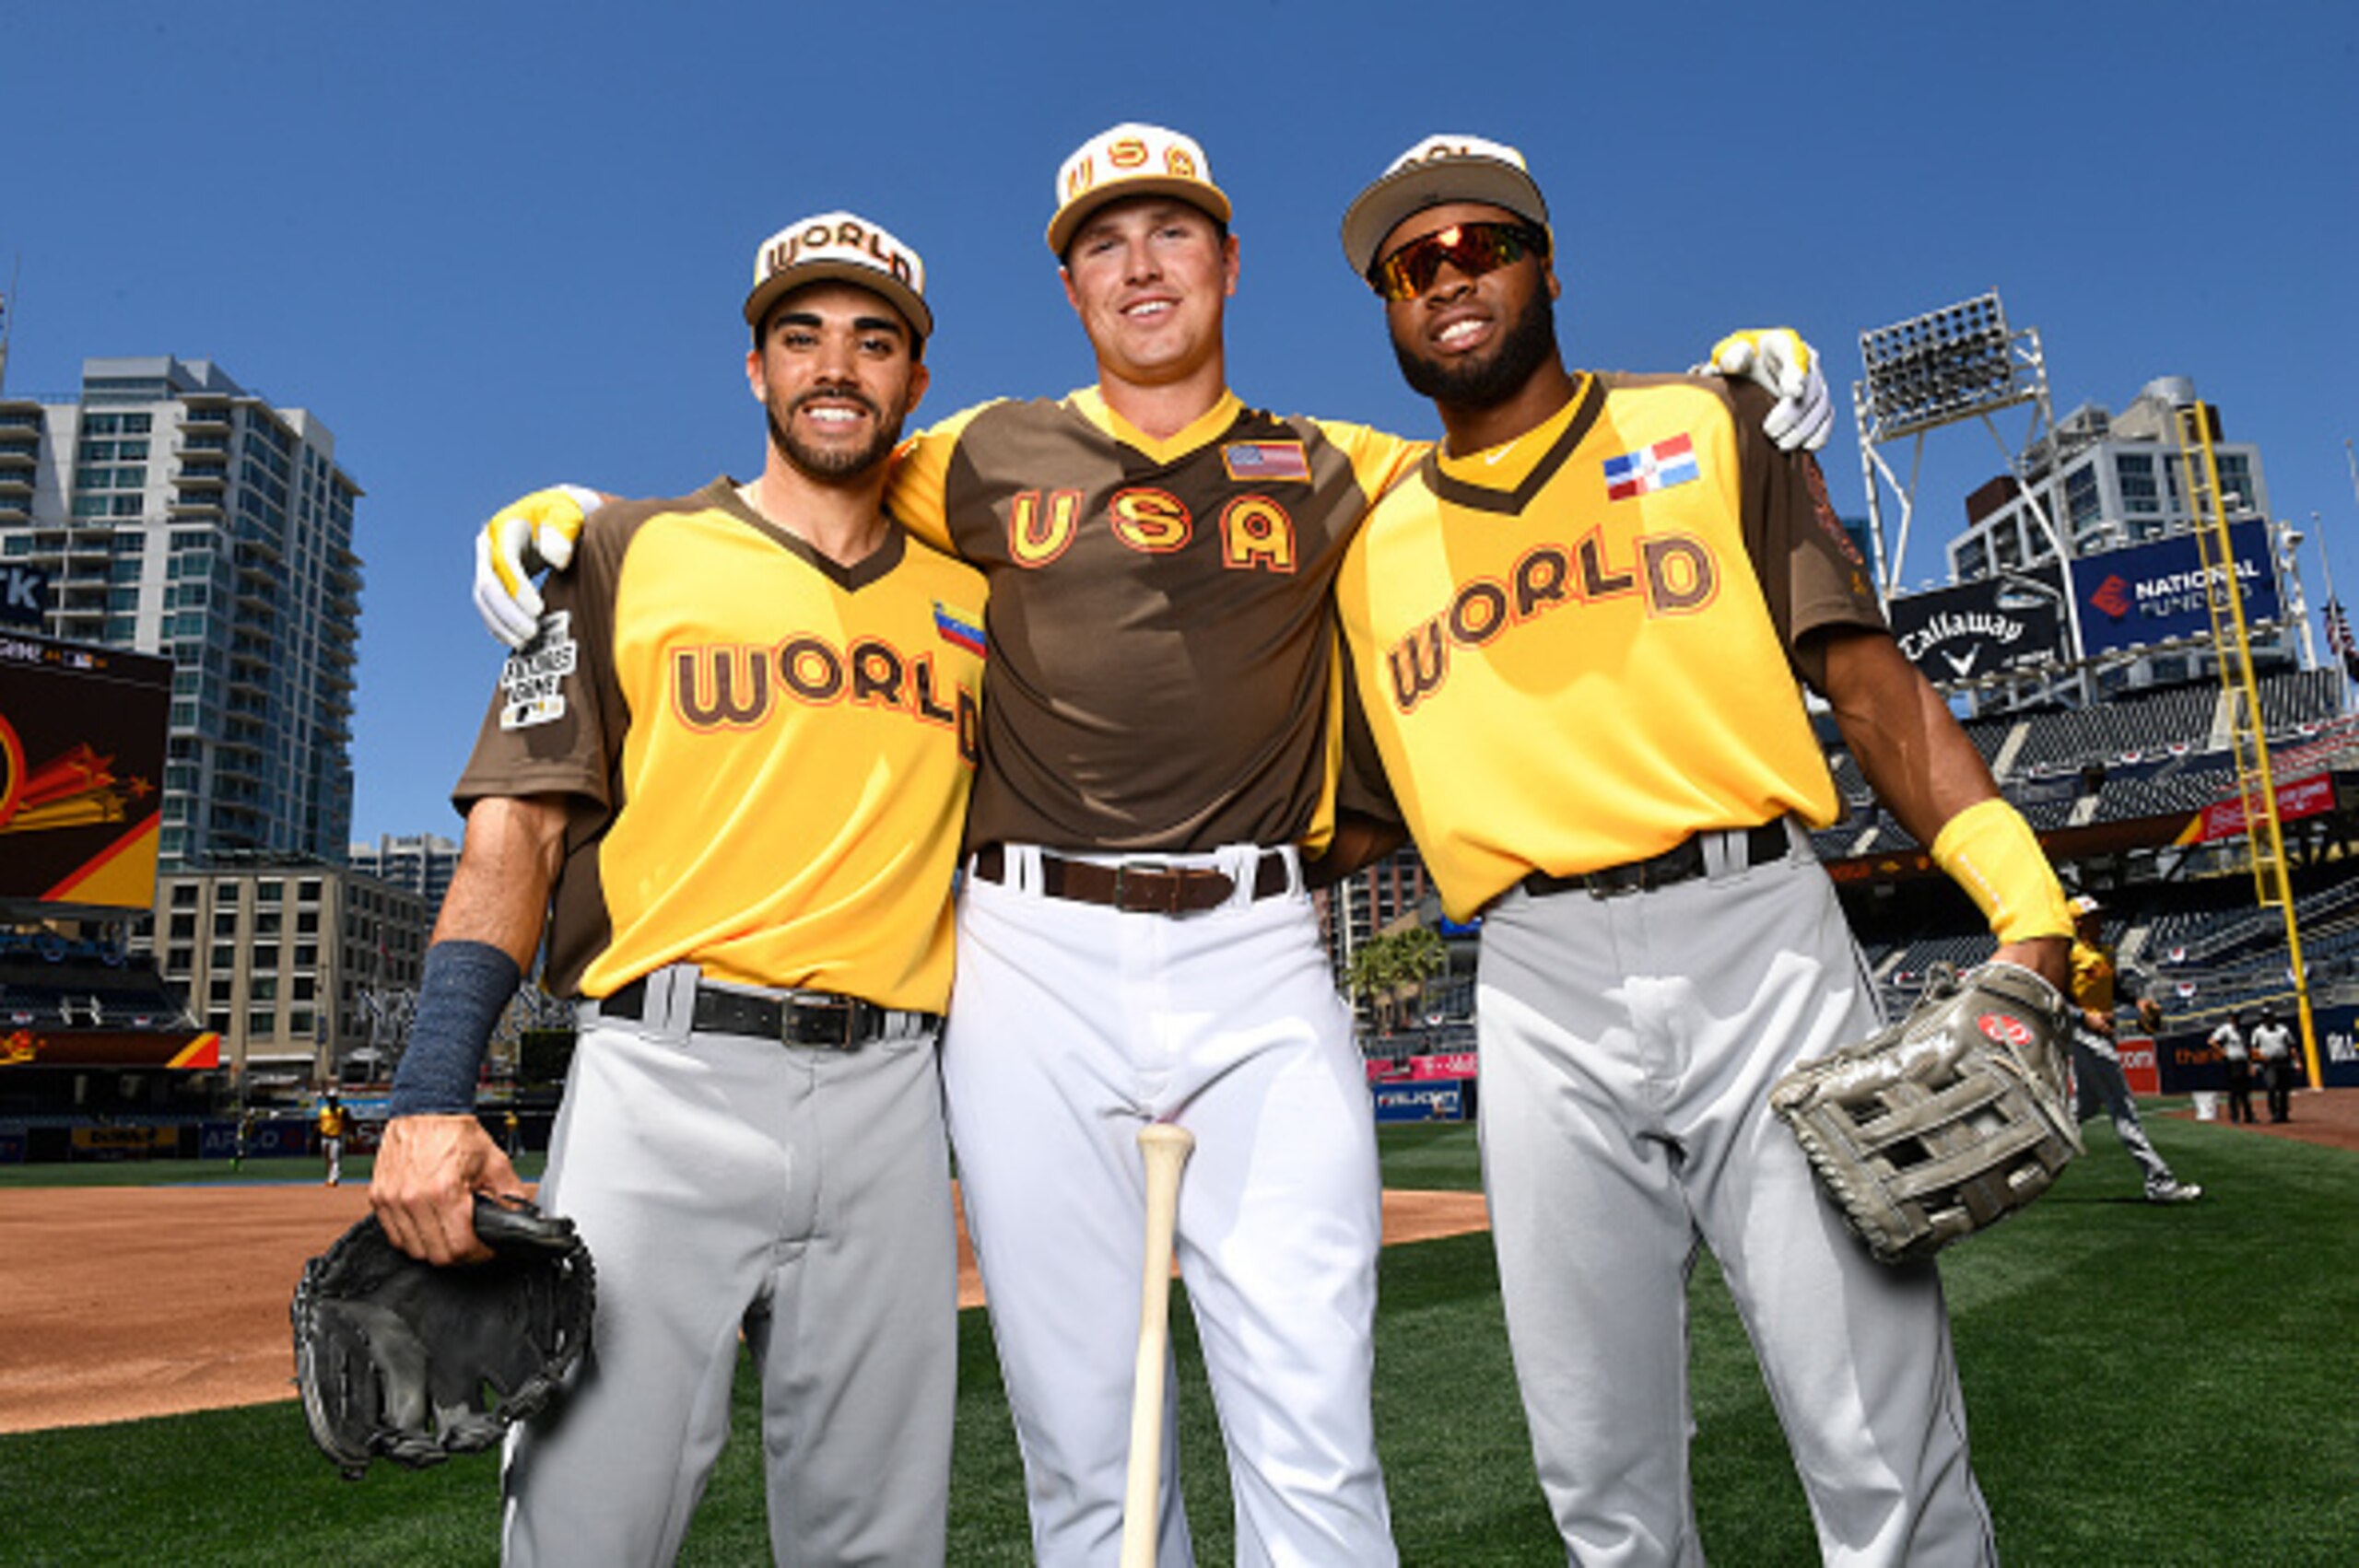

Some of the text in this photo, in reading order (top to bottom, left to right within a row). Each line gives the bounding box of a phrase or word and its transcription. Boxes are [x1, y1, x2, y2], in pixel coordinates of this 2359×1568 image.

[767, 221, 912, 286] WORLD
[1008, 487, 1297, 574] USA
[0, 567, 41, 610] K
[2135, 558, 2260, 601] NATIONAL
[1387, 522, 1720, 716] WORLD
[1897, 610, 2025, 661] Callaway
[670, 630, 980, 771] WORLD
